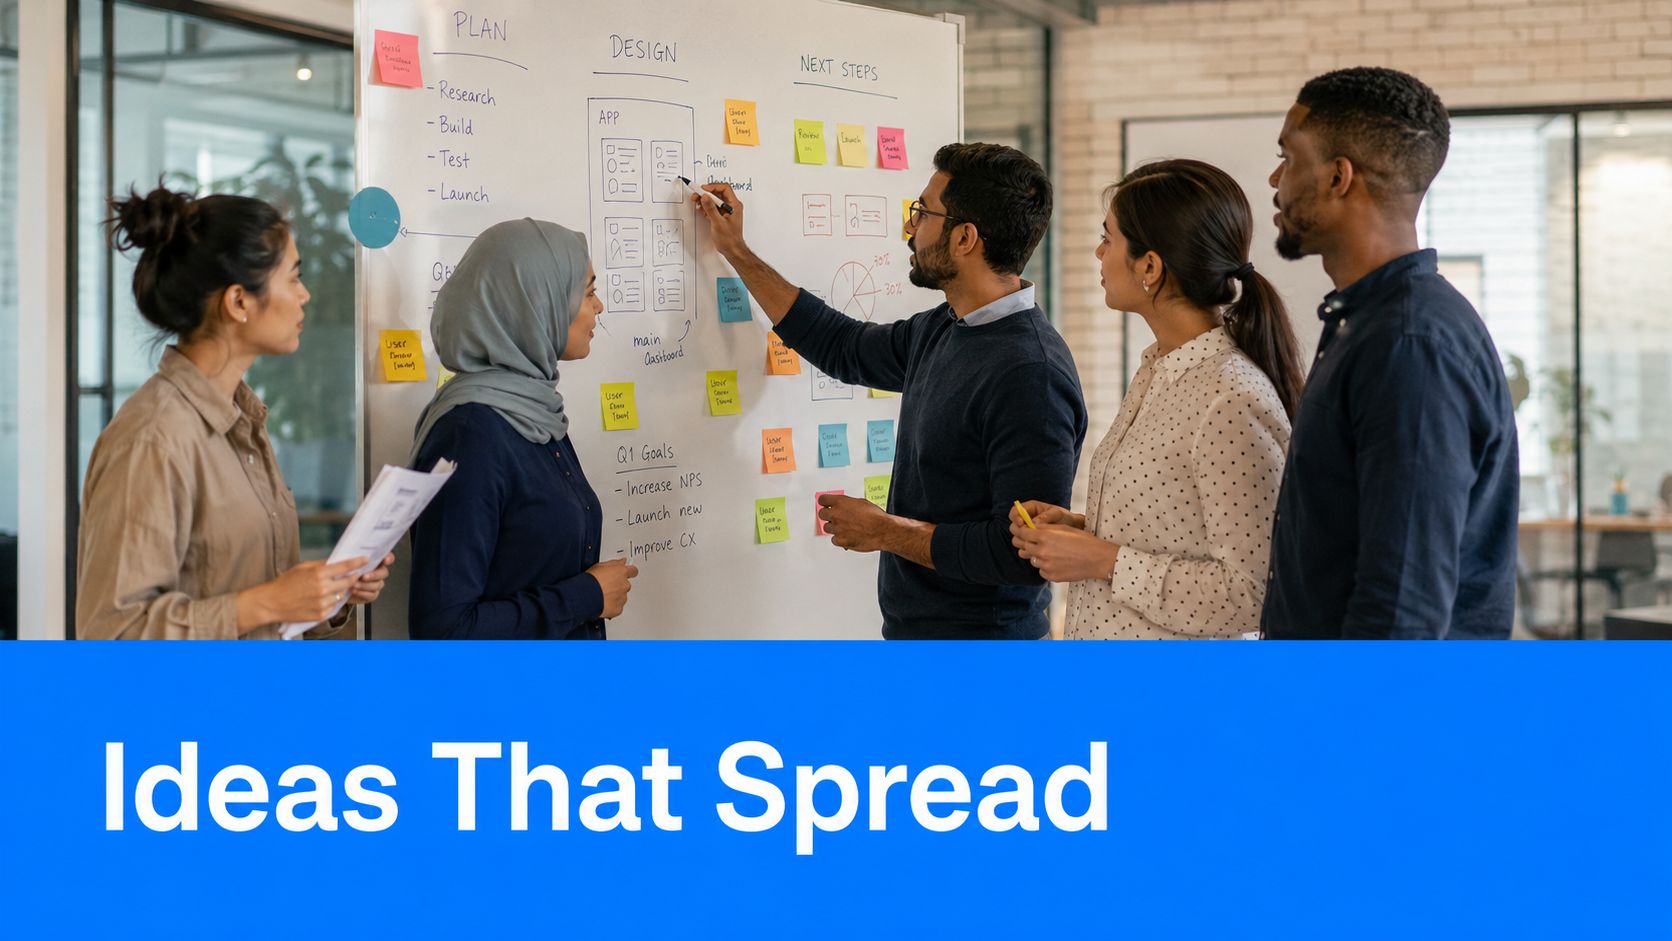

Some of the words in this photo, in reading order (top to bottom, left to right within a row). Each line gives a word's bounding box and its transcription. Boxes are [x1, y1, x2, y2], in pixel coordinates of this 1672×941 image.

[453, 10, 508, 41] PLAN
[609, 34, 677, 63] DESIGN
[800, 54, 834, 75] NEXT
[841, 61, 878, 82] STEPS
[439, 79, 497, 106] Research
[439, 115, 474, 136] Build
[598, 109, 620, 126] APP
[439, 149, 471, 169] Test
[440, 182, 490, 203] Launch
[633, 332, 661, 347] main
[616, 445, 634, 464] Q1
[641, 443, 675, 462] Goals
[626, 479, 673, 497] Increase
[679, 472, 703, 489] NPS
[627, 504, 671, 526] Launch
[678, 506, 703, 517] new
[629, 539, 674, 561] Improve
[679, 532, 697, 546] CX
